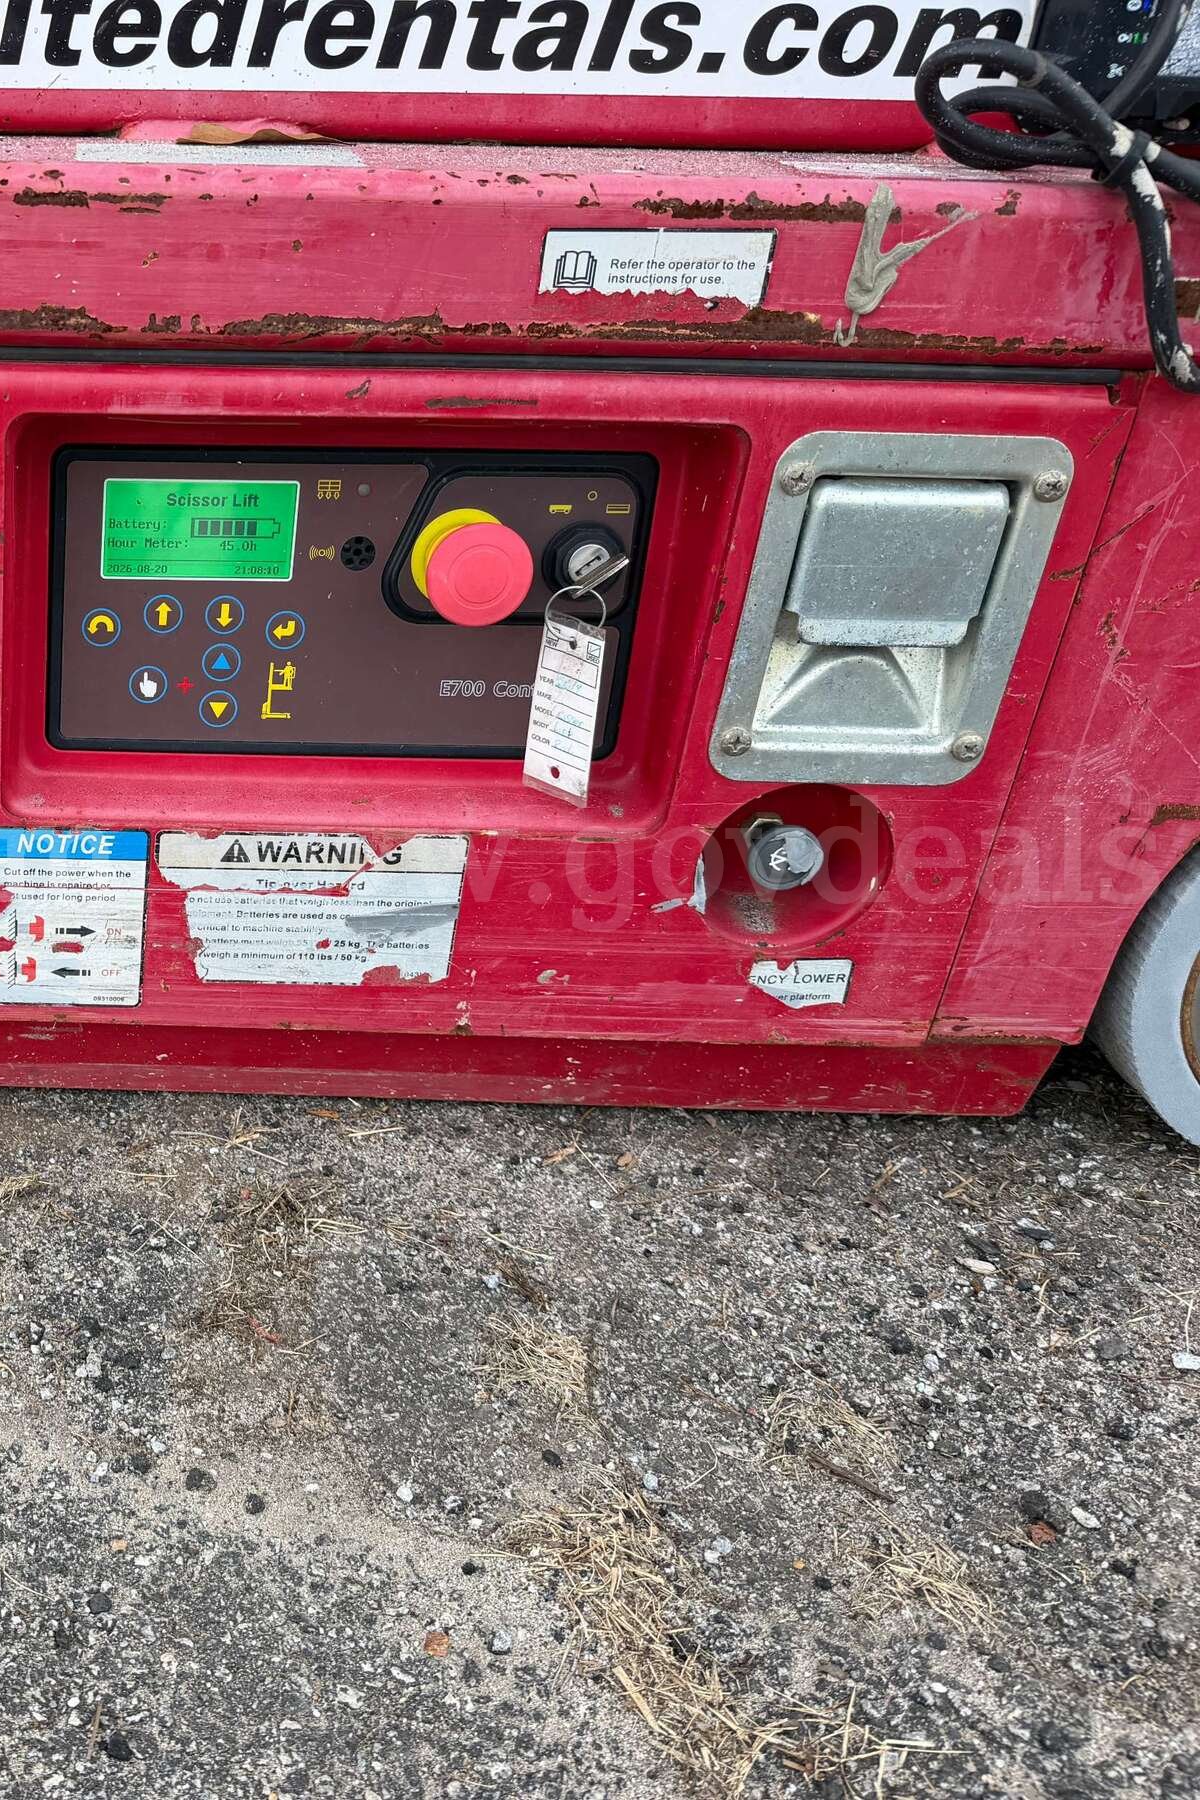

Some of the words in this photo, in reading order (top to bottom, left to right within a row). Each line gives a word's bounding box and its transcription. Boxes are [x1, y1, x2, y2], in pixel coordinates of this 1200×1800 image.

[610, 258, 642, 270] Refer
[646, 259, 664, 270] the
[668, 260, 720, 274] operator
[722, 260, 734, 270] to
[736, 260, 756, 270] the
[607, 273, 678, 284] instructions
[681, 274, 698, 285] for
[699, 276, 725, 285] use.
[166, 493, 228, 507] Scissor
[232, 494, 260, 508] Lift
[109, 519, 168, 532] Battery:
[107, 537, 137, 549] Hour
[144, 538, 190, 549] Meter:
[539, 674, 555, 686] YEAR
[439, 679, 486, 697] E700
[534, 705, 554, 717] MODEL
[532, 719, 550, 730] BODY
[531, 733, 551, 746] COLOR
[16, 832, 116, 855] NOTICE
[257, 840, 403, 865] WARNIG
[3, 867, 21, 876] Cut
[23, 868, 36, 876] off
[37, 868, 53, 877] the
[55, 869, 86, 880] power
[87, 870, 114, 878] when
[115, 870, 132, 878] the
[21, 892, 45, 900] used
[46, 893, 60, 901] for
[62, 893, 84, 903] long
[85, 893, 116, 903] period
[282, 911, 298, 919] are
[300, 911, 324, 920] used
[106, 927, 122, 937] ON
[231, 924, 241, 932] to
[243, 925, 284, 933] machine
[333, 940, 346, 948] 25
[386, 941, 430, 950] batteries
[203, 951, 231, 960] weigh
[240, 951, 281, 960] minimum
[285, 952, 297, 960] of
[298, 953, 315, 961] 110
[317, 953, 332, 961] lbs
[340, 953, 353, 962] 50
[101, 969, 121, 977] OFF
[793, 973, 846, 984] LOWER
[789, 992, 831, 1002] platform
